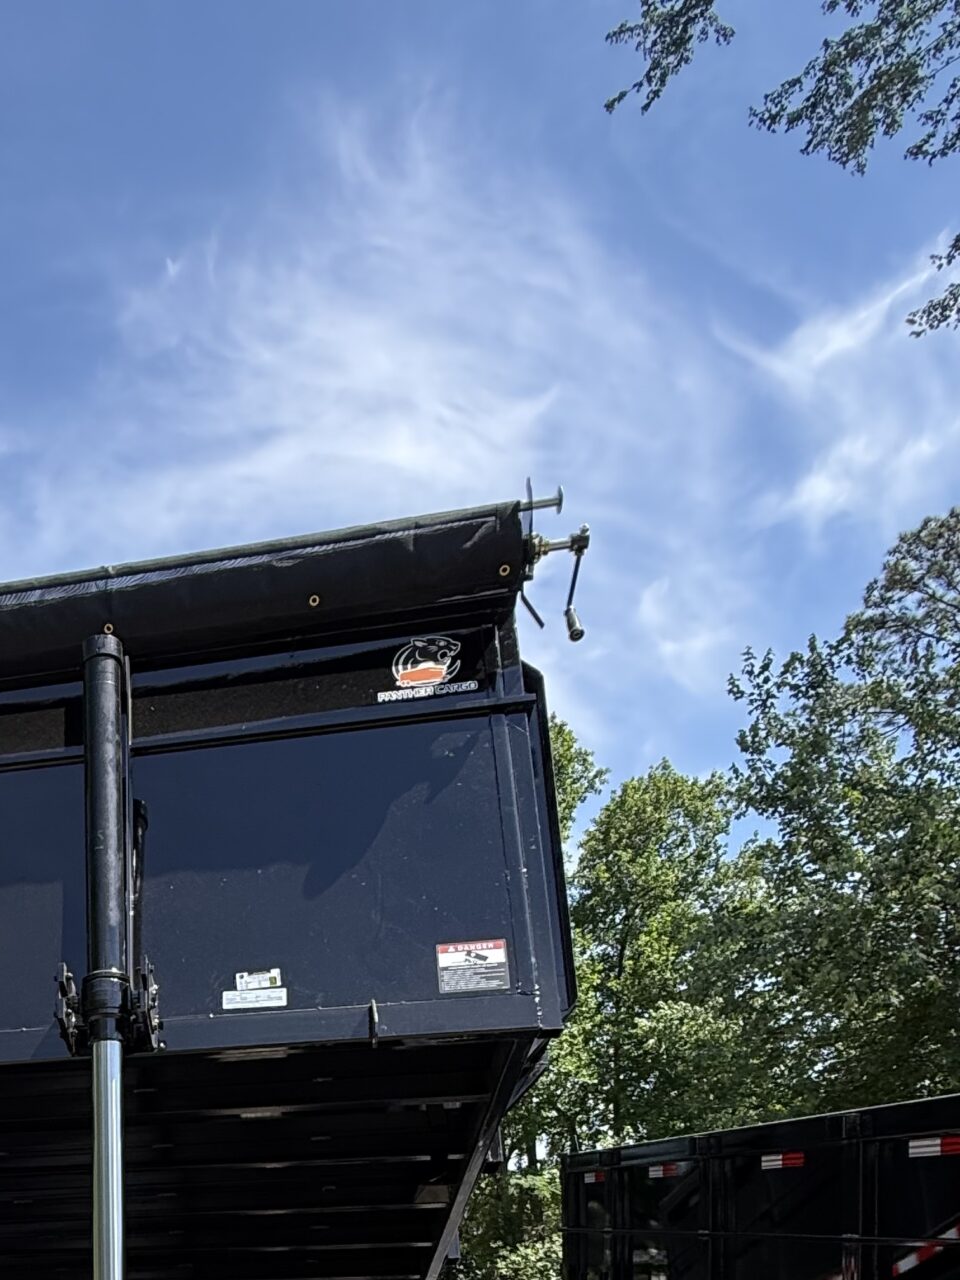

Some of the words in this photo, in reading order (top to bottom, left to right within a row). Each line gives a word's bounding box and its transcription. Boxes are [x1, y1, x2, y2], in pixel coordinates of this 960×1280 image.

[377, 686, 434, 702] PANTHER
[435, 681, 478, 695] CARGO
[457, 943, 495, 952] DANGER
